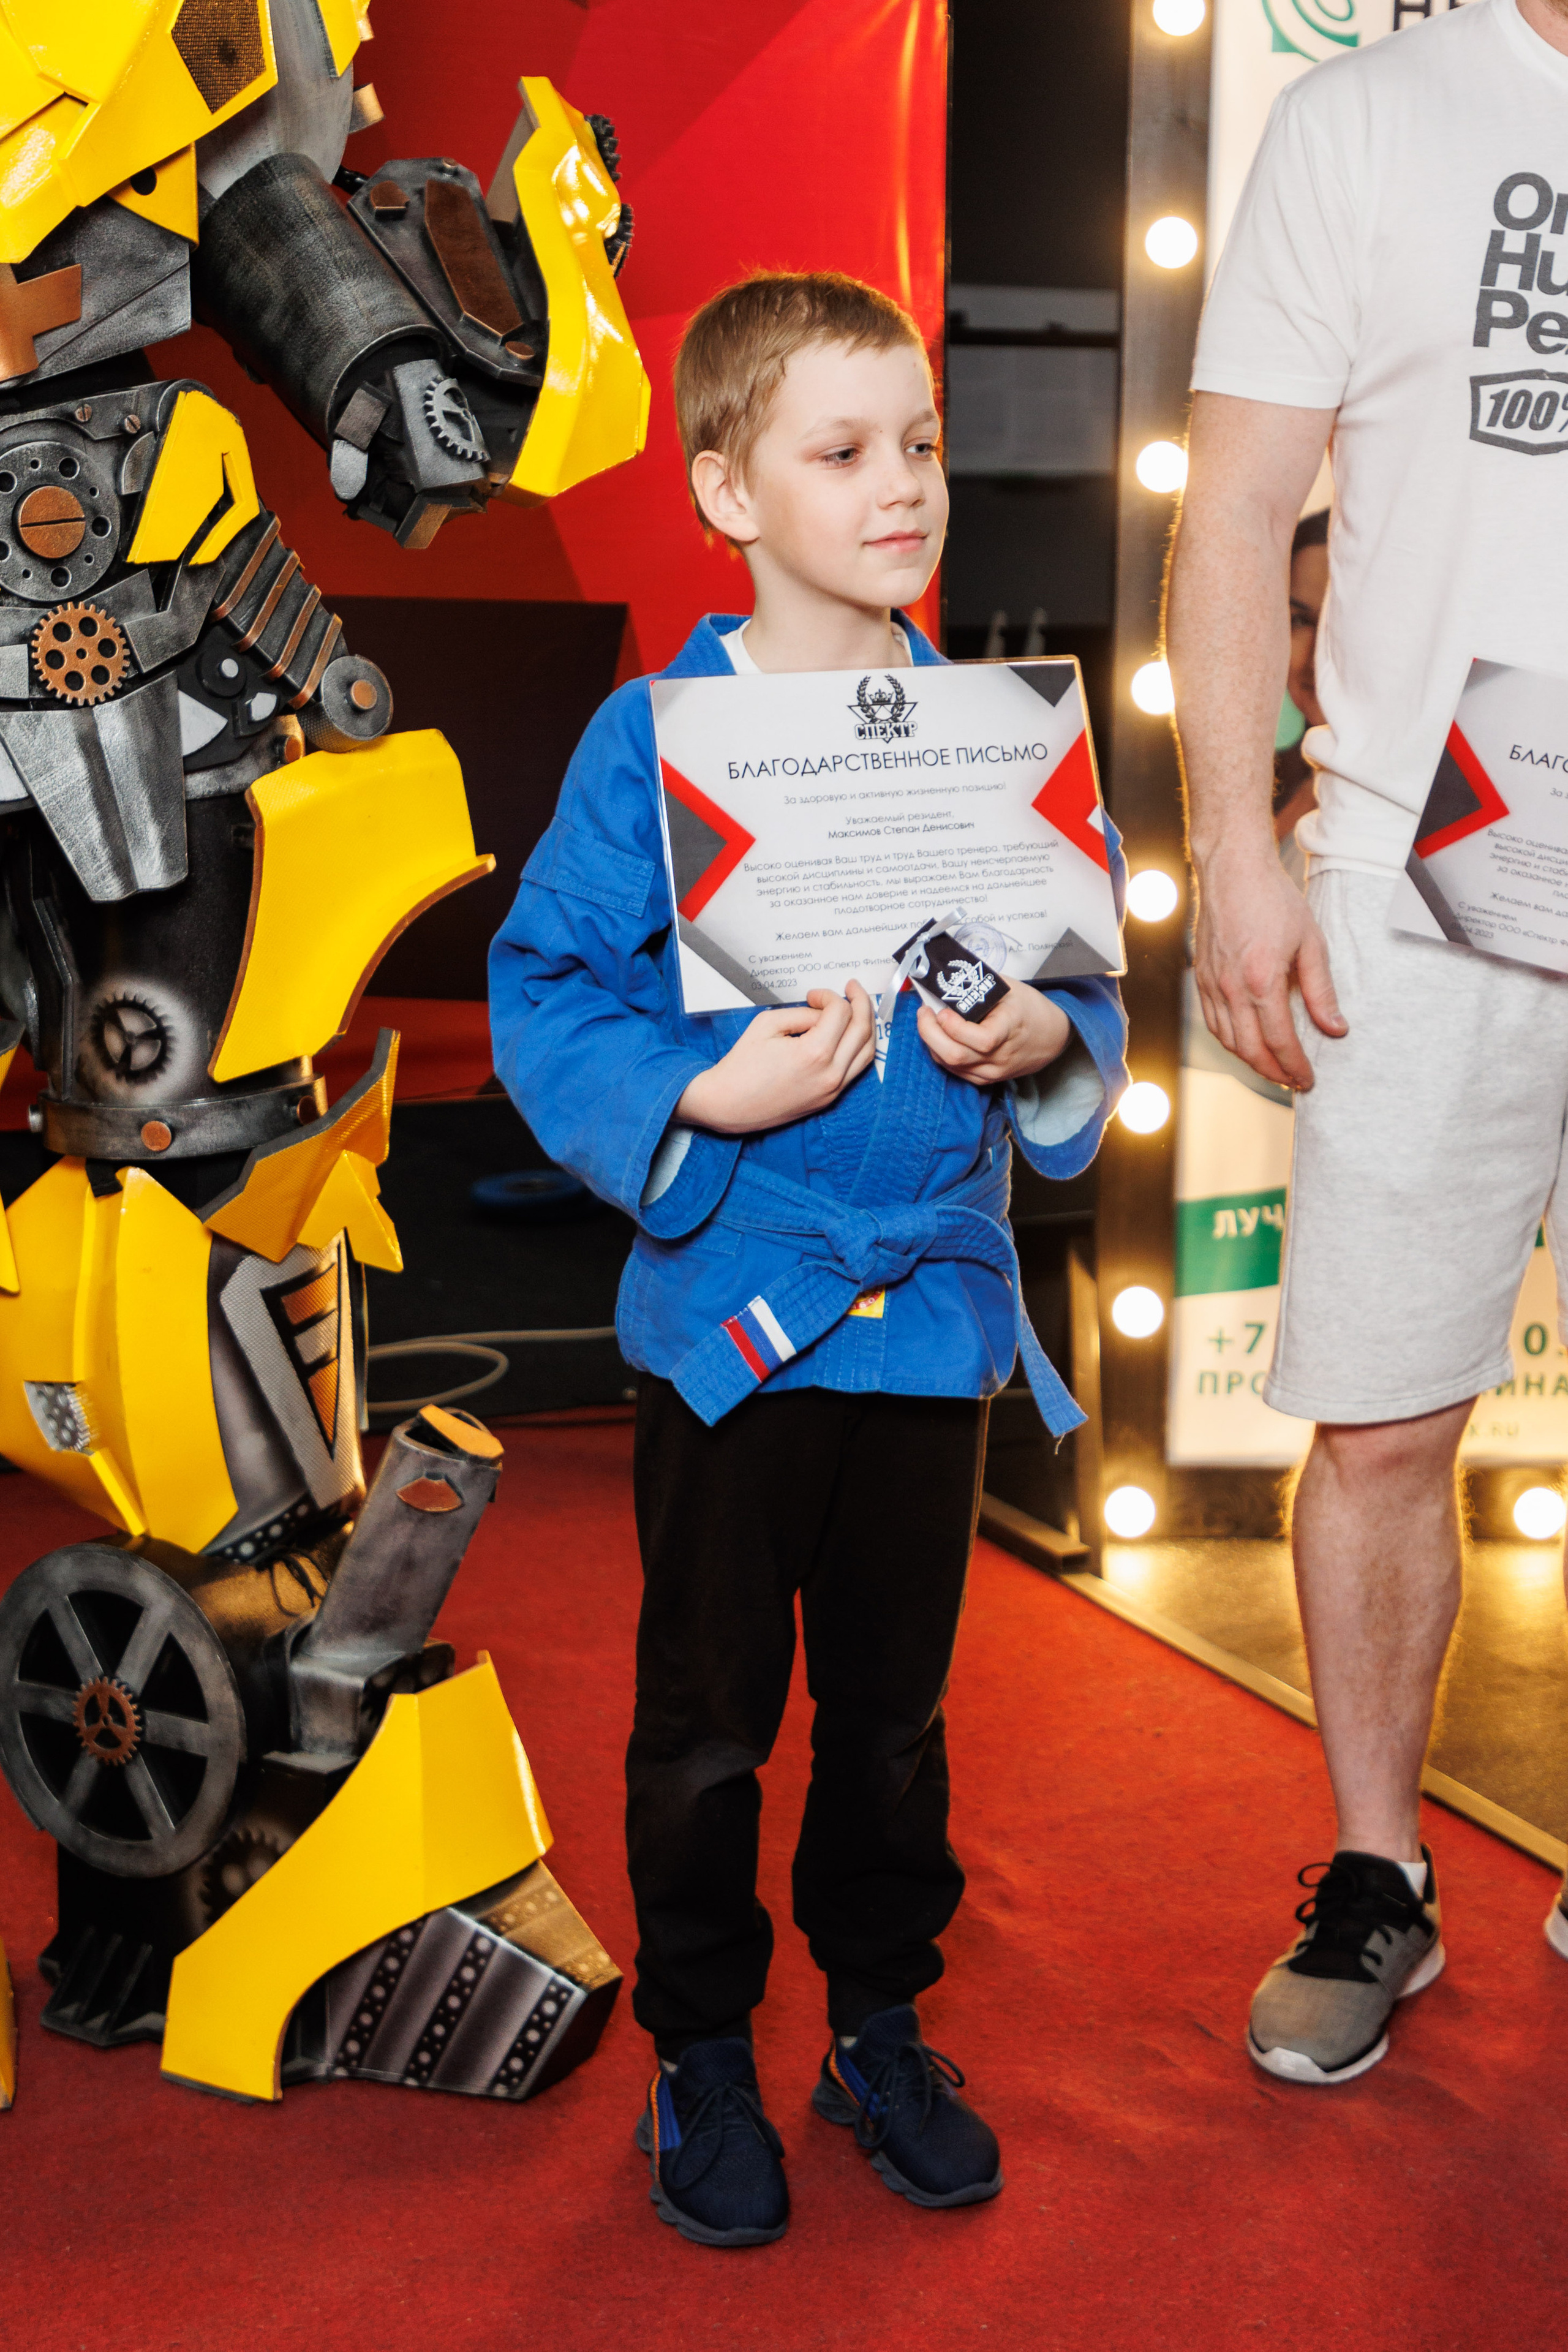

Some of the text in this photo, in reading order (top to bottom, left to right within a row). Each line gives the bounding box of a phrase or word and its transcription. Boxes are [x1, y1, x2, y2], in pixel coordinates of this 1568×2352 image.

[854, 721, 918, 740] СПЕКТР
[728, 743, 1048, 779] БЛАГОДАРСТВЕННОЕ ПИСЬМО
[784, 796, 796, 805] За
[799, 793, 848, 804] здоровую
[859, 788, 903, 799] активную
[906, 784, 960, 796] жизненную
[962, 781, 1006, 791] позицию!
[828, 821, 975, 839] Максимов Степан Денисович
[845, 812, 905, 825] Уважаемый
[1487, 827, 1523, 843] Высоко
[744, 862, 782, 872] Высоко
[785, 858, 832, 869] оценивая
[835, 855, 857, 864] Ваш
[860, 853, 882, 864] труд
[893, 850, 915, 862] труд
[917, 848, 954, 858] Вашего
[1003, 839, 1059, 852] требующий
[757, 872, 800, 883] высокой
[802, 869, 864, 881] дисциплины
[942, 859, 968, 869] Вашу
[971, 853, 1050, 866] неисчерпаемую
[756, 886, 801, 897] энергию
[886, 876, 902, 885] мы
[903, 873, 957, 884] выражаем
[959, 870, 979, 880] Вам
[982, 865, 1054, 878] благодарность
[784, 895, 839, 907] оказанное
[865, 889, 908, 900] доверие
[920, 884, 970, 895] надеемся
[987, 878, 1047, 890] дальнейшее
[834, 894, 989, 915] плодотворное сотрудничество!
[775, 930, 820, 941] Желаем
[823, 928, 843, 937] вам
[846, 921, 908, 935] дальнейших
[965, 913, 996, 924] собой
[1006, 910, 1048, 923] успехов!
[748, 951, 813, 964] С уважением
[750, 966, 796, 978] Директор
[797, 963, 821, 972] ООО
[824, 960, 861, 971] «Спектр
[751, 978, 797, 990] 03.04.2023
[956, 973, 997, 1014] СПЕКТР
[1483, 1373, 1568, 1396] ИНА
